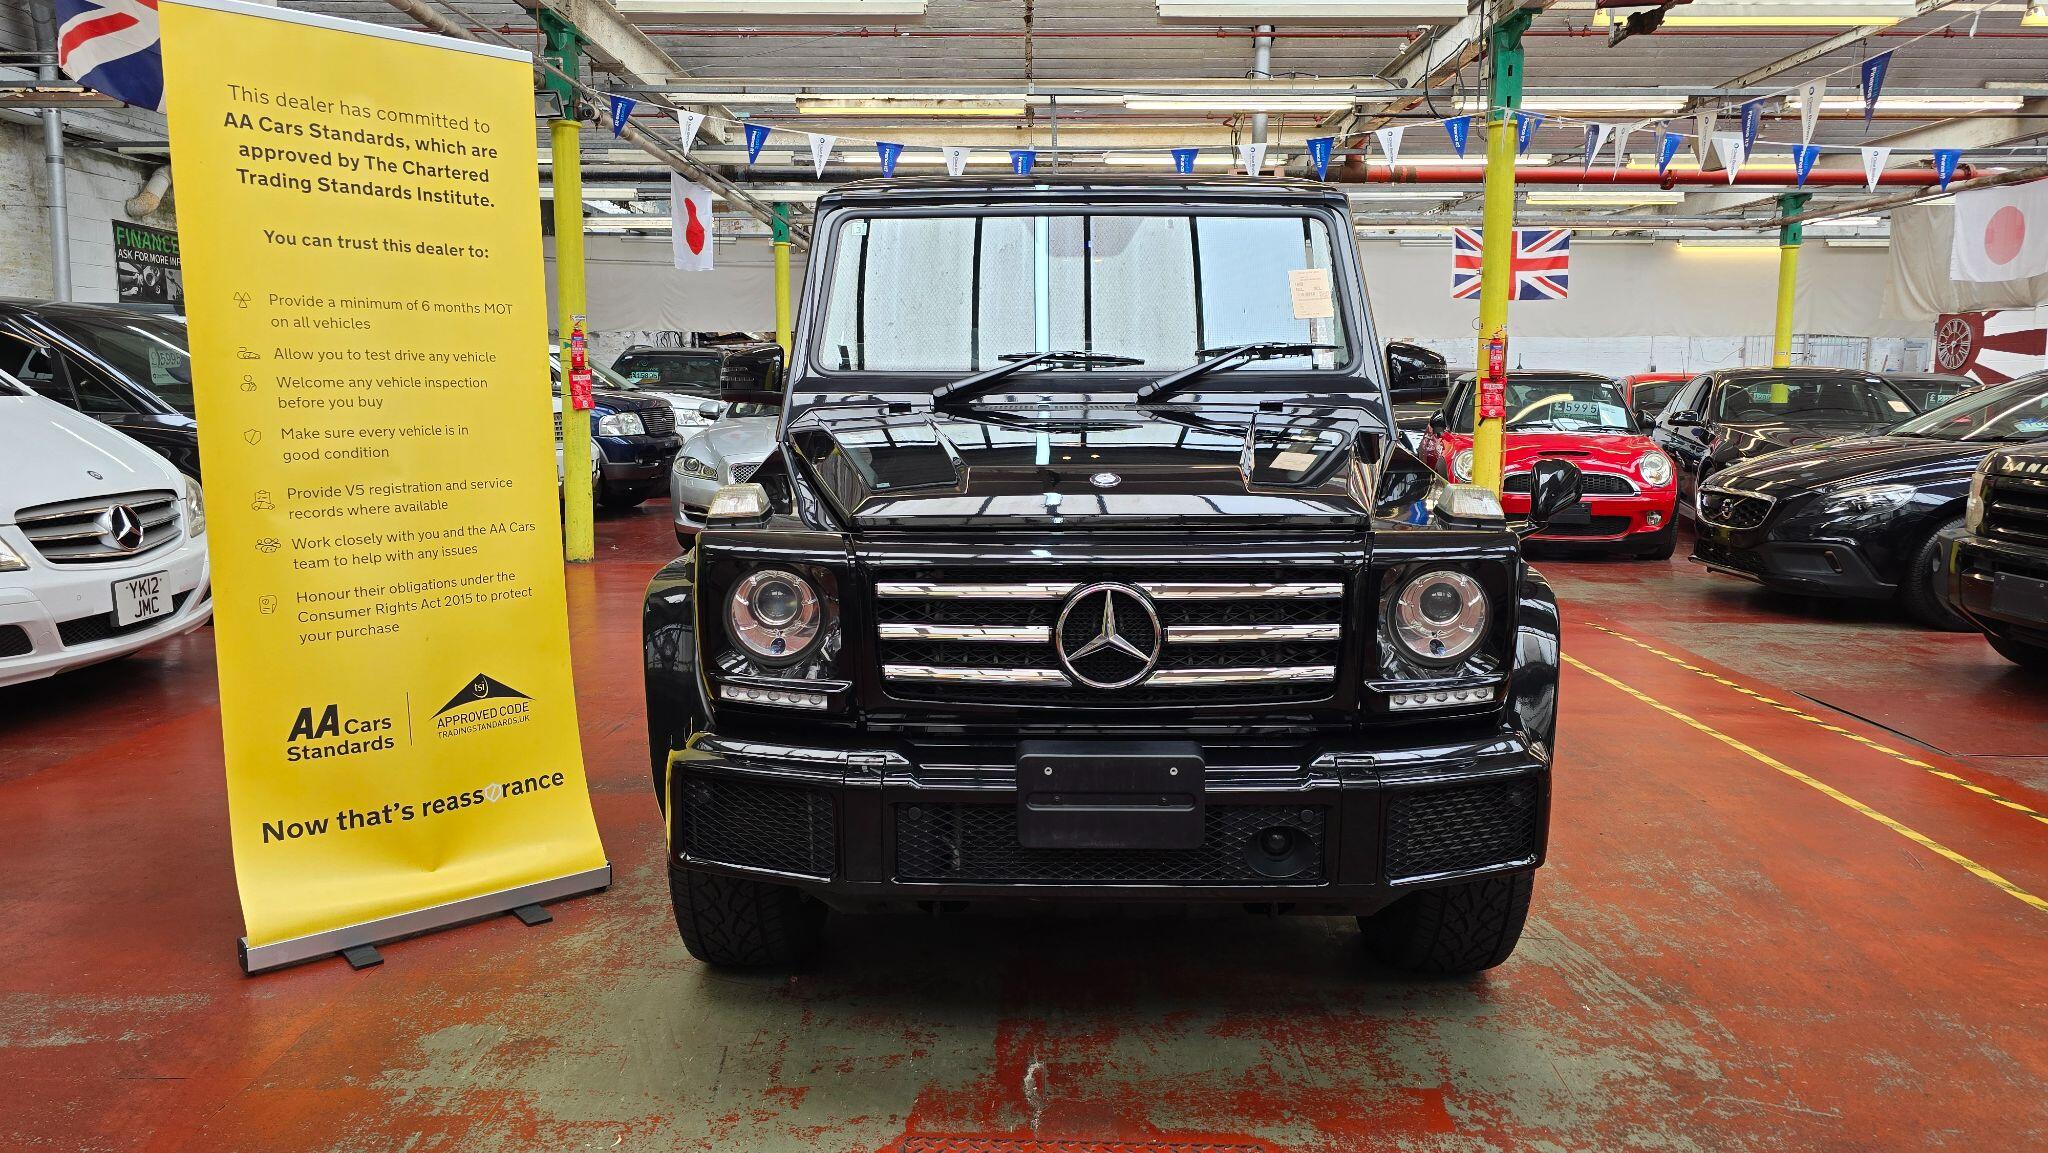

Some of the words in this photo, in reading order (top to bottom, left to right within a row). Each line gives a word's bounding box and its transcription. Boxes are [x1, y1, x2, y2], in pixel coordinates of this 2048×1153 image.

[227, 84, 269, 104] This
[276, 92, 334, 113] dealer
[340, 100, 371, 118] has
[377, 110, 468, 131] committed
[474, 119, 490, 133] to
[224, 112, 254, 130] AA
[259, 117, 303, 136] Cars
[309, 123, 410, 151] Standards,
[415, 138, 466, 155] which
[472, 147, 497, 158] are
[239, 145, 332, 166] approved
[338, 152, 359, 171] by
[364, 155, 397, 173] The
[403, 161, 489, 182] Chartered
[236, 168, 311, 193] Trading
[318, 177, 412, 200] Standards
[417, 187, 494, 207] Institute.
[117, 226, 179, 254] FINANCE
[263, 230, 296, 245] You
[302, 236, 332, 247] can
[337, 235, 378, 250] trust
[382, 239, 411, 252] this
[416, 241, 464, 256] dealer
[468, 245, 488, 258] to:
[118, 249, 133, 260] ASK
[134, 251, 150, 262] FOR
[150, 254, 169, 265] MORE
[269, 294, 323, 307] Provide
[328, 299, 335, 307] a
[341, 297, 402, 310] minimum
[407, 300, 418, 310] of
[422, 300, 430, 311] 6
[434, 303, 480, 313] months
[485, 303, 512, 314] MOT
[271, 319, 288, 327] on
[294, 316, 310, 328] all
[313, 317, 370, 329] vehicles
[274, 348, 313, 359] Allow
[318, 352, 343, 362] you
[347, 349, 361, 360] to
[365, 349, 391, 360] test
[395, 350, 425, 361] drive
[429, 353, 449, 364] any
[453, 352, 496, 362] vehicle
[276, 376, 344, 388] Welcome
[349, 378, 372, 390] any
[376, 377, 421, 387] vehicle
[425, 377, 487, 390] inspection
[278, 397, 324, 408] before
[329, 399, 353, 410] you
[358, 396, 383, 409] buy
[281, 428, 320, 439] Make
[325, 430, 354, 438] sure
[359, 428, 395, 439] every
[399, 425, 442, 436] vehicle
[445, 425, 454, 435] is
[459, 427, 468, 435] in
[283, 448, 319, 463] good
[325, 447, 389, 459] condition
[288, 486, 341, 499] Provide
[345, 485, 364, 496] V5
[370, 482, 441, 496] registration
[446, 480, 467, 490] and
[471, 480, 512, 489] service
[289, 506, 343, 519] records
[347, 504, 390, 515] where
[395, 500, 448, 513] available
[291, 537, 331, 549] Work
[335, 533, 382, 546] closely
[386, 530, 414, 542] with
[418, 531, 439, 542] you
[443, 526, 464, 538] and
[467, 525, 486, 536] the
[490, 523, 506, 534] AA
[510, 522, 535, 532] Cars
[293, 559, 329, 569] team
[334, 556, 347, 566] to
[352, 553, 381, 565] help
[386, 549, 413, 561] with
[417, 550, 438, 560] any
[442, 546, 477, 557] issues
[129, 577, 159, 598] YK12
[297, 590, 350, 603] Honour
[354, 586, 385, 597] their
[390, 579, 457, 594] obligations
[461, 574, 494, 586] under
[497, 572, 515, 582] the
[135, 597, 159, 618] JMC
[298, 608, 371, 622] Consumer
[376, 601, 417, 615] Rights
[421, 597, 441, 609] Act
[444, 592, 472, 606] 2015
[476, 593, 487, 602] to
[491, 587, 532, 603] protect
[299, 632, 332, 645] your
[336, 624, 399, 641] purchase
[287, 704, 339, 742] AA
[344, 718, 391, 734] Cars
[437, 707, 498, 729] APPROVED
[500, 700, 531, 716] CODE
[287, 735, 394, 761] Standards
[262, 818, 328, 843] Now
[336, 803, 414, 830] that's
